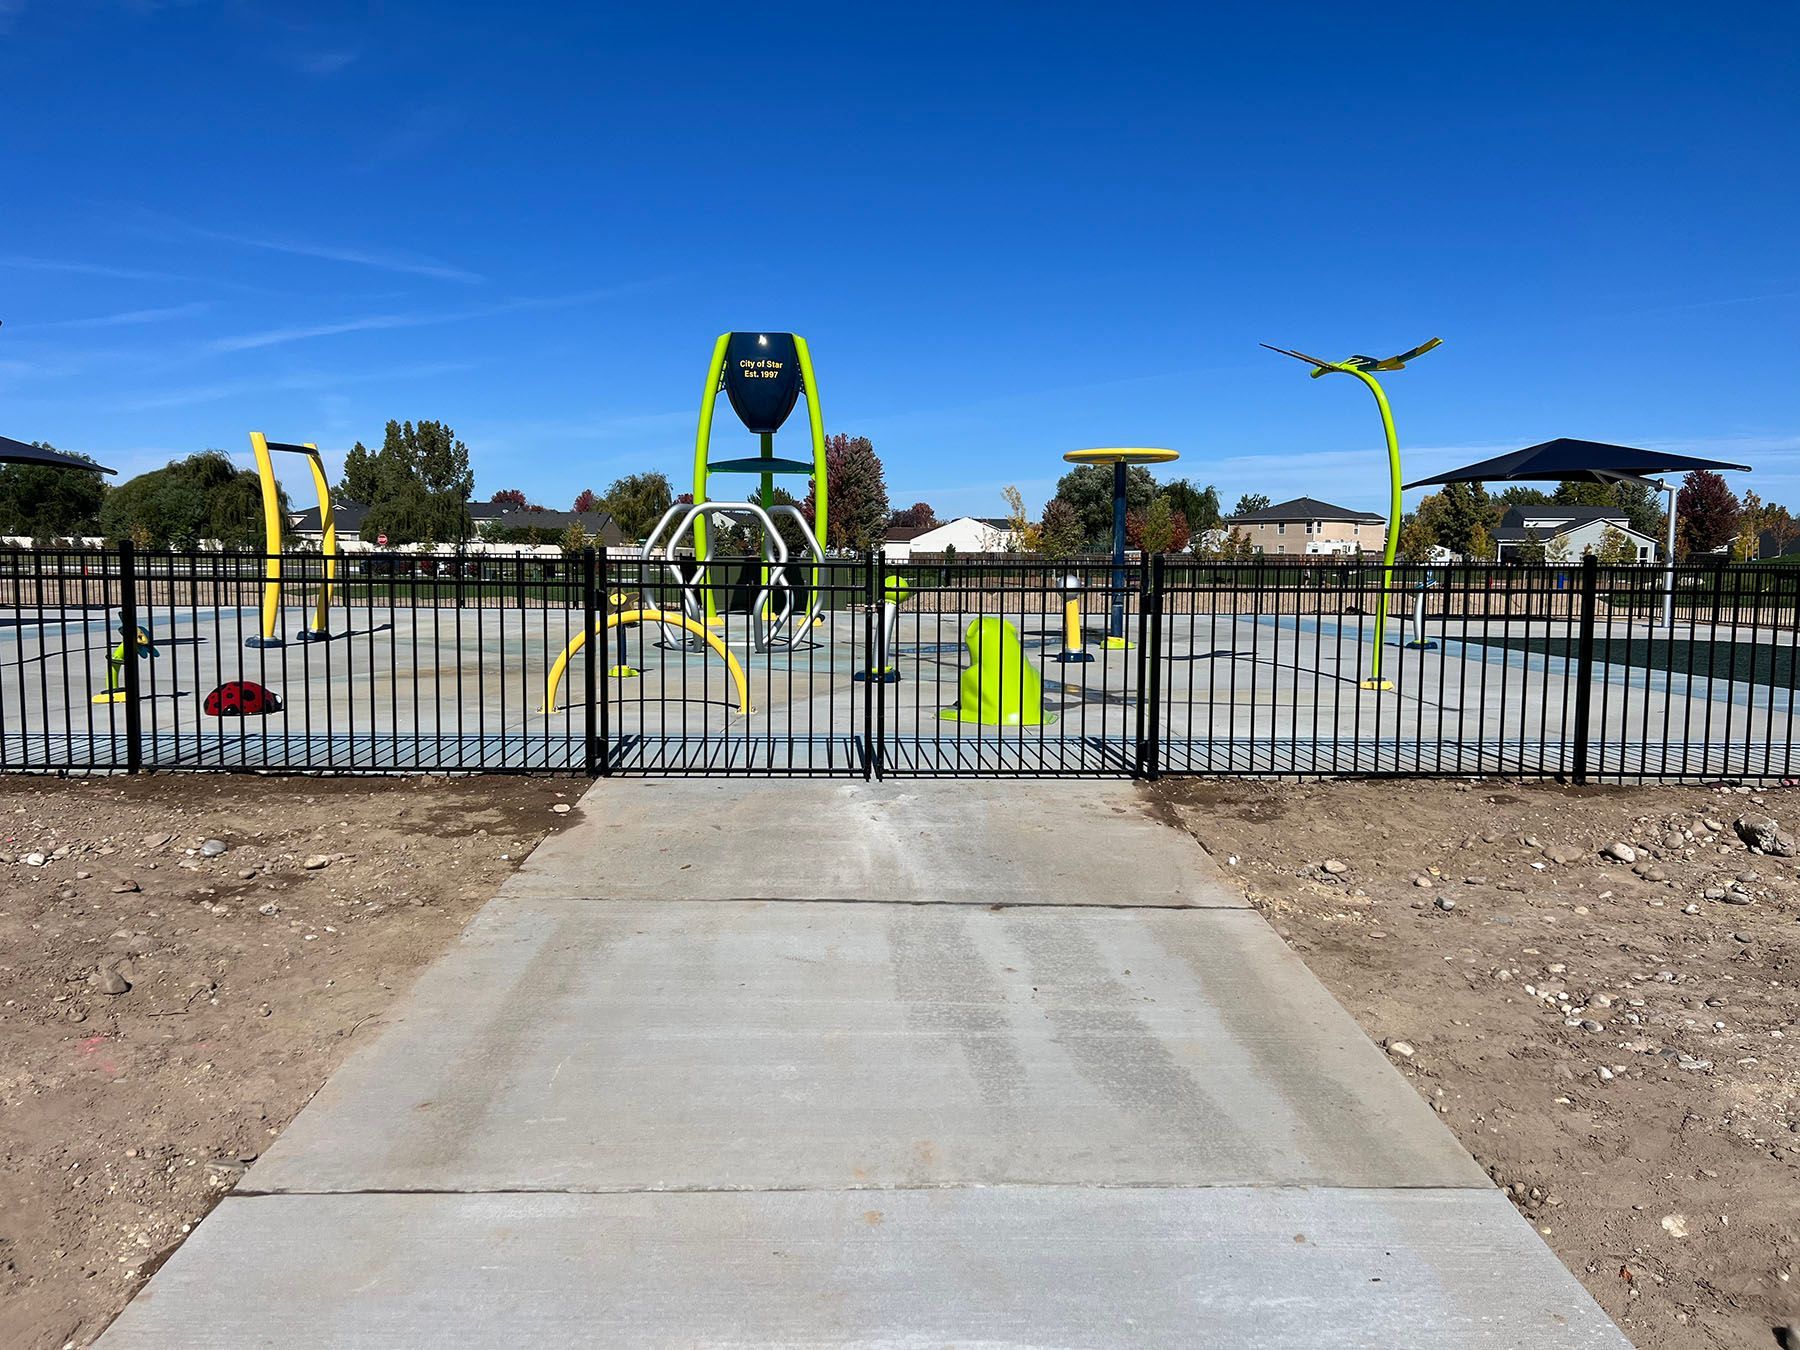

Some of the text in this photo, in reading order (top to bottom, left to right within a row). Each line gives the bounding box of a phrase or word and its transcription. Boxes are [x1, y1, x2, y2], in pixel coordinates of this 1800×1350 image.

[740, 360, 755, 369] City
[766, 360, 783, 369] Star
[744, 370, 759, 378] Est.
